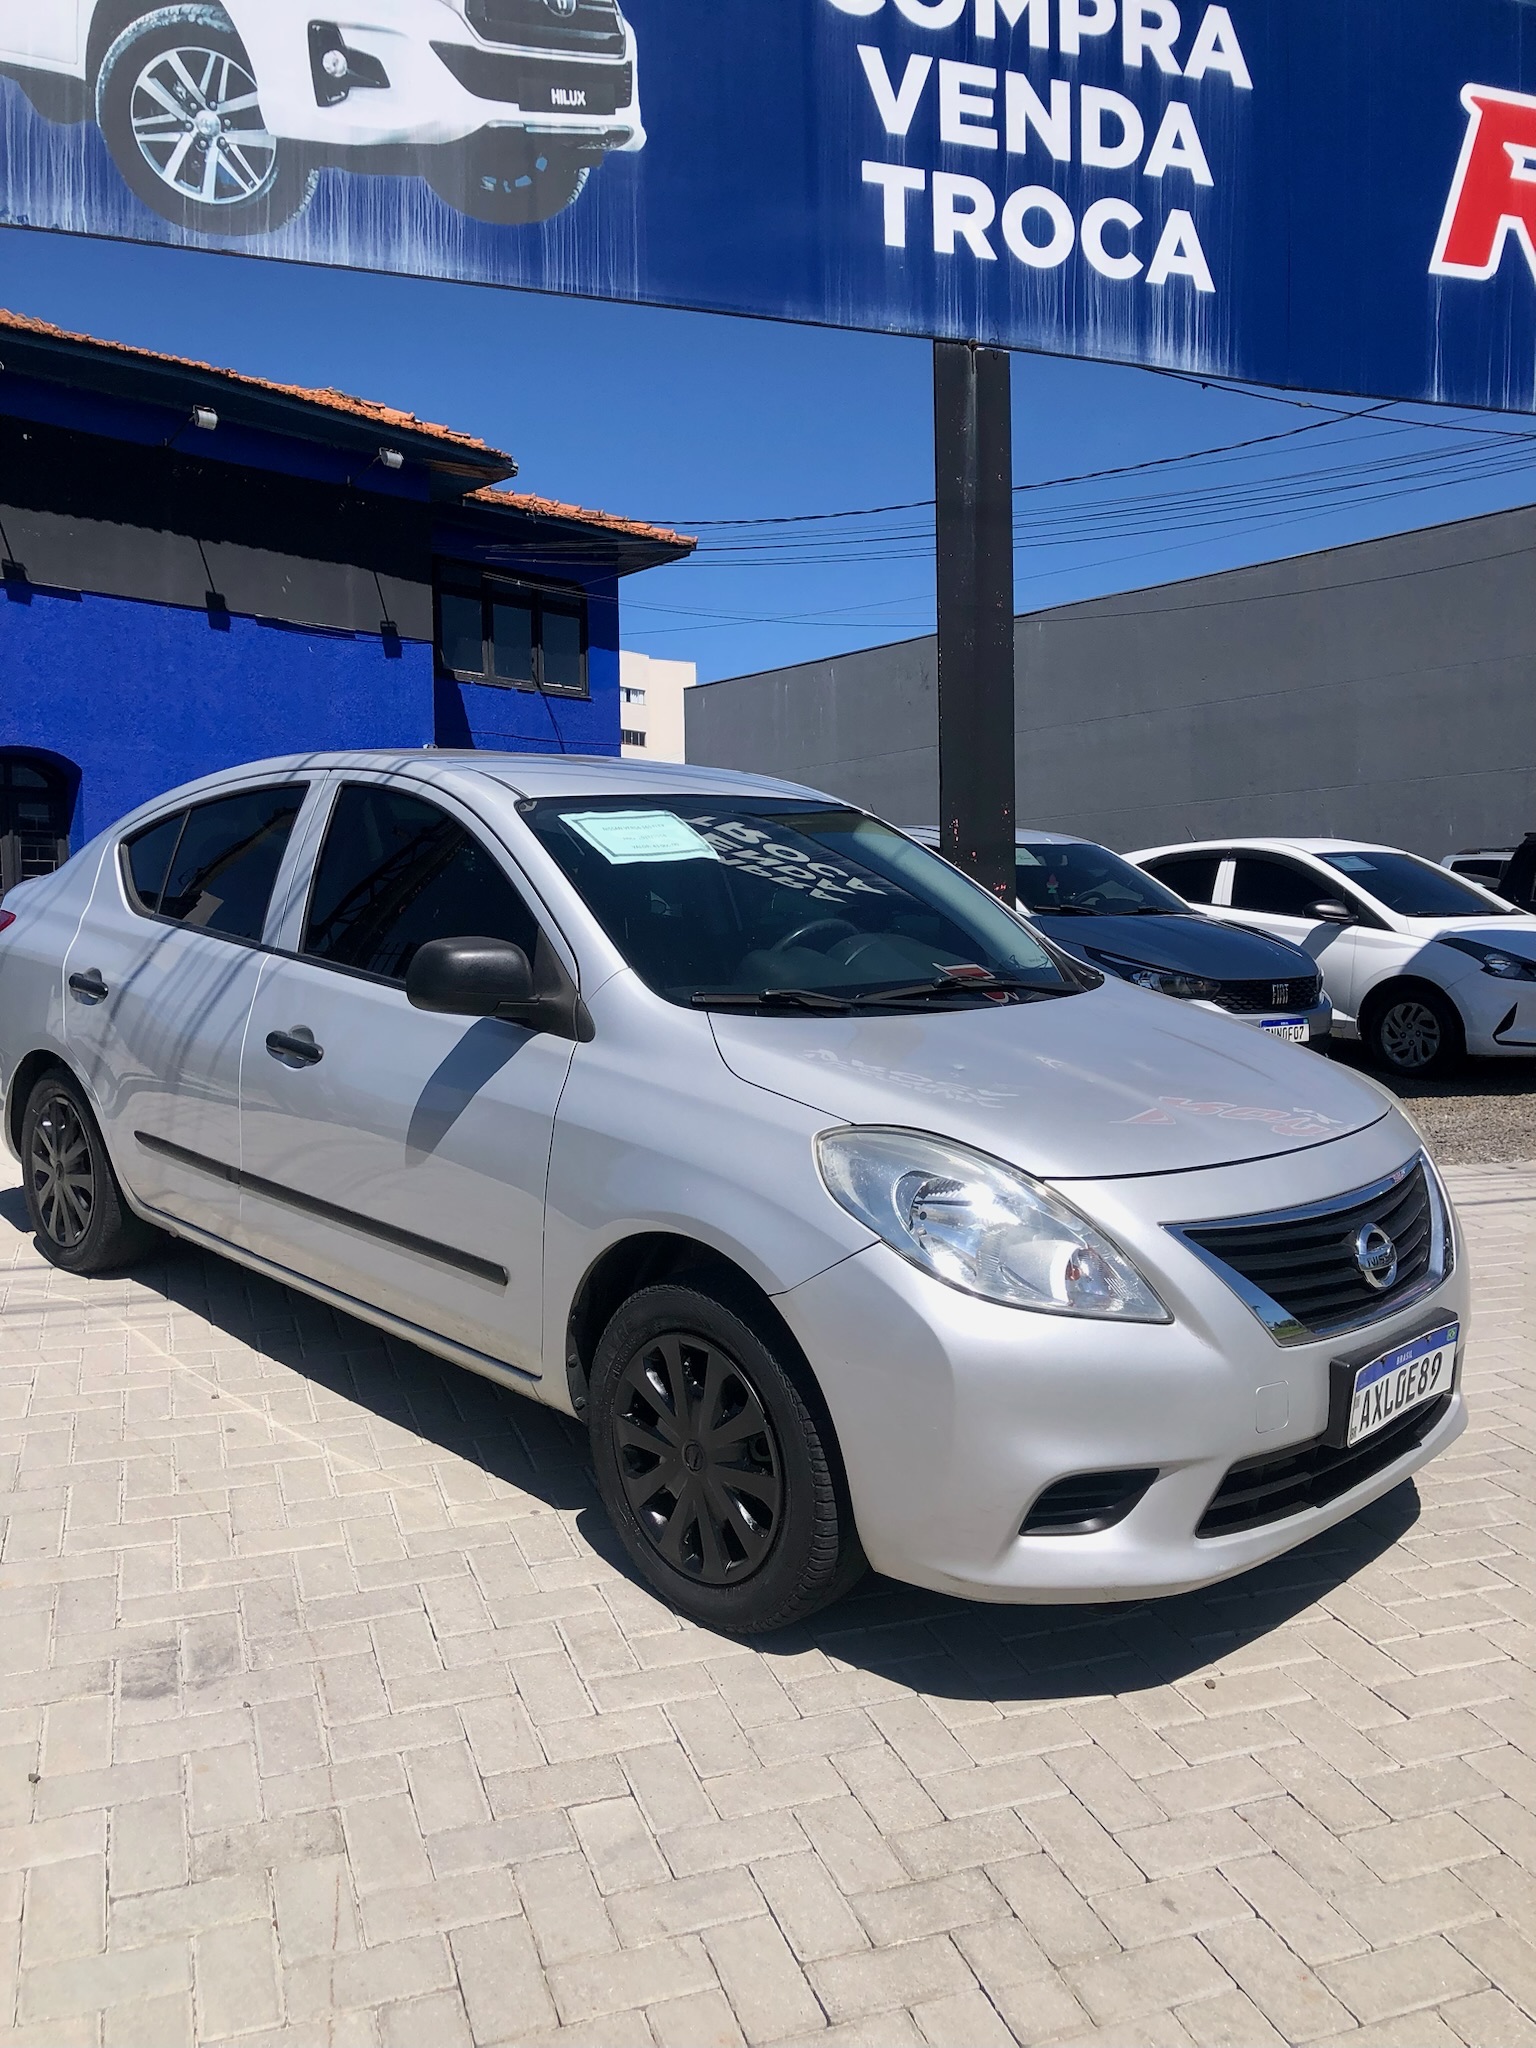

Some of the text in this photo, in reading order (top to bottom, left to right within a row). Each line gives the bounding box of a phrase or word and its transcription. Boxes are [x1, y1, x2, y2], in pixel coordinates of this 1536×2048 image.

[827, 0, 1253, 90] MPRA
[551, 88, 587, 106] HILUX
[857, 44, 1214, 187] VENDA
[861, 160, 1216, 293] TROCA
[1272, 984, 1289, 1005] FIAT
[1396, 1350, 1413, 1366] BRASIL
